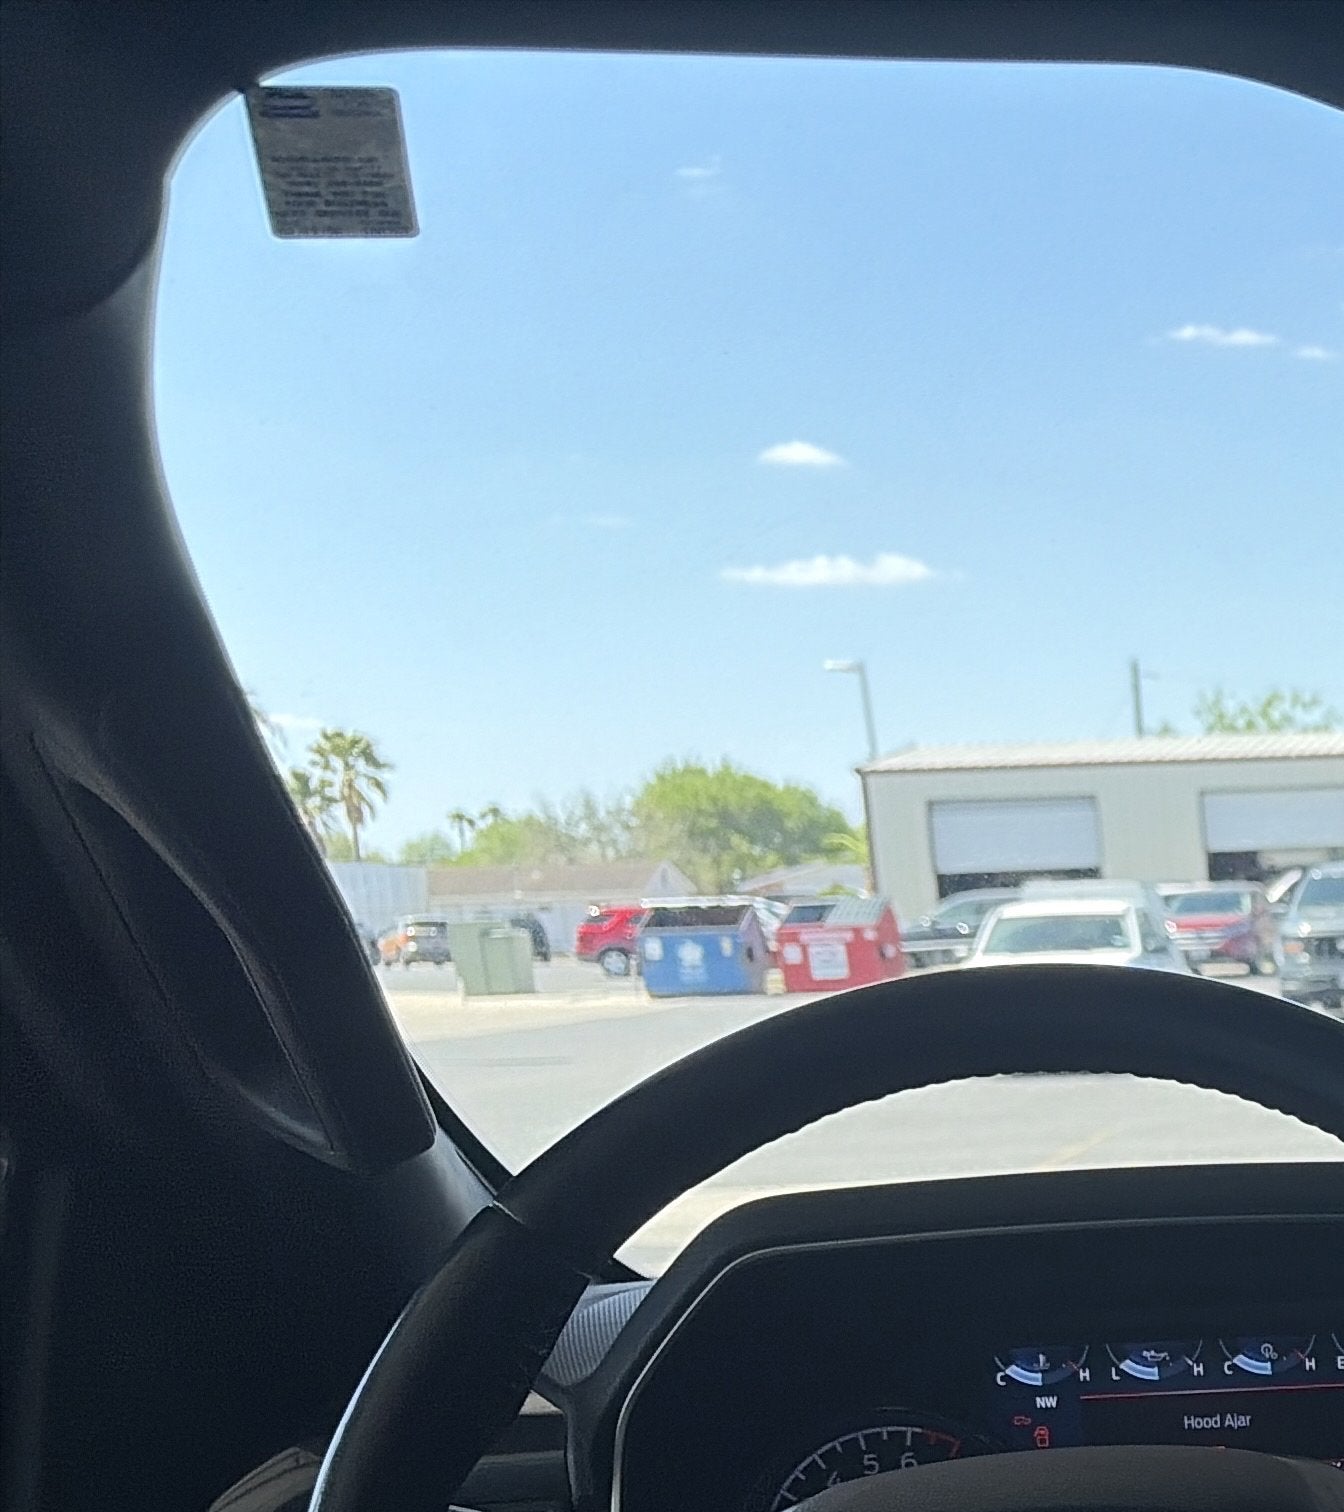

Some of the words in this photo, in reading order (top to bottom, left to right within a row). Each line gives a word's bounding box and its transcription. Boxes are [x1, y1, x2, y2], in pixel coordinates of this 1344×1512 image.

[1193, 1362, 1204, 1377] H
[1223, 1360, 1234, 1375] C
[1305, 1357, 1316, 1371] H
[996, 1372, 1007, 1386] C
[1079, 1367, 1090, 1382] H
[1111, 1366, 1121, 1381] L
[1035, 1396, 1058, 1409] NW
[1183, 1413, 1221, 1430] Hood
[1224, 1412, 1252, 1430] Ajar
[863, 1454, 880, 1475] 5
